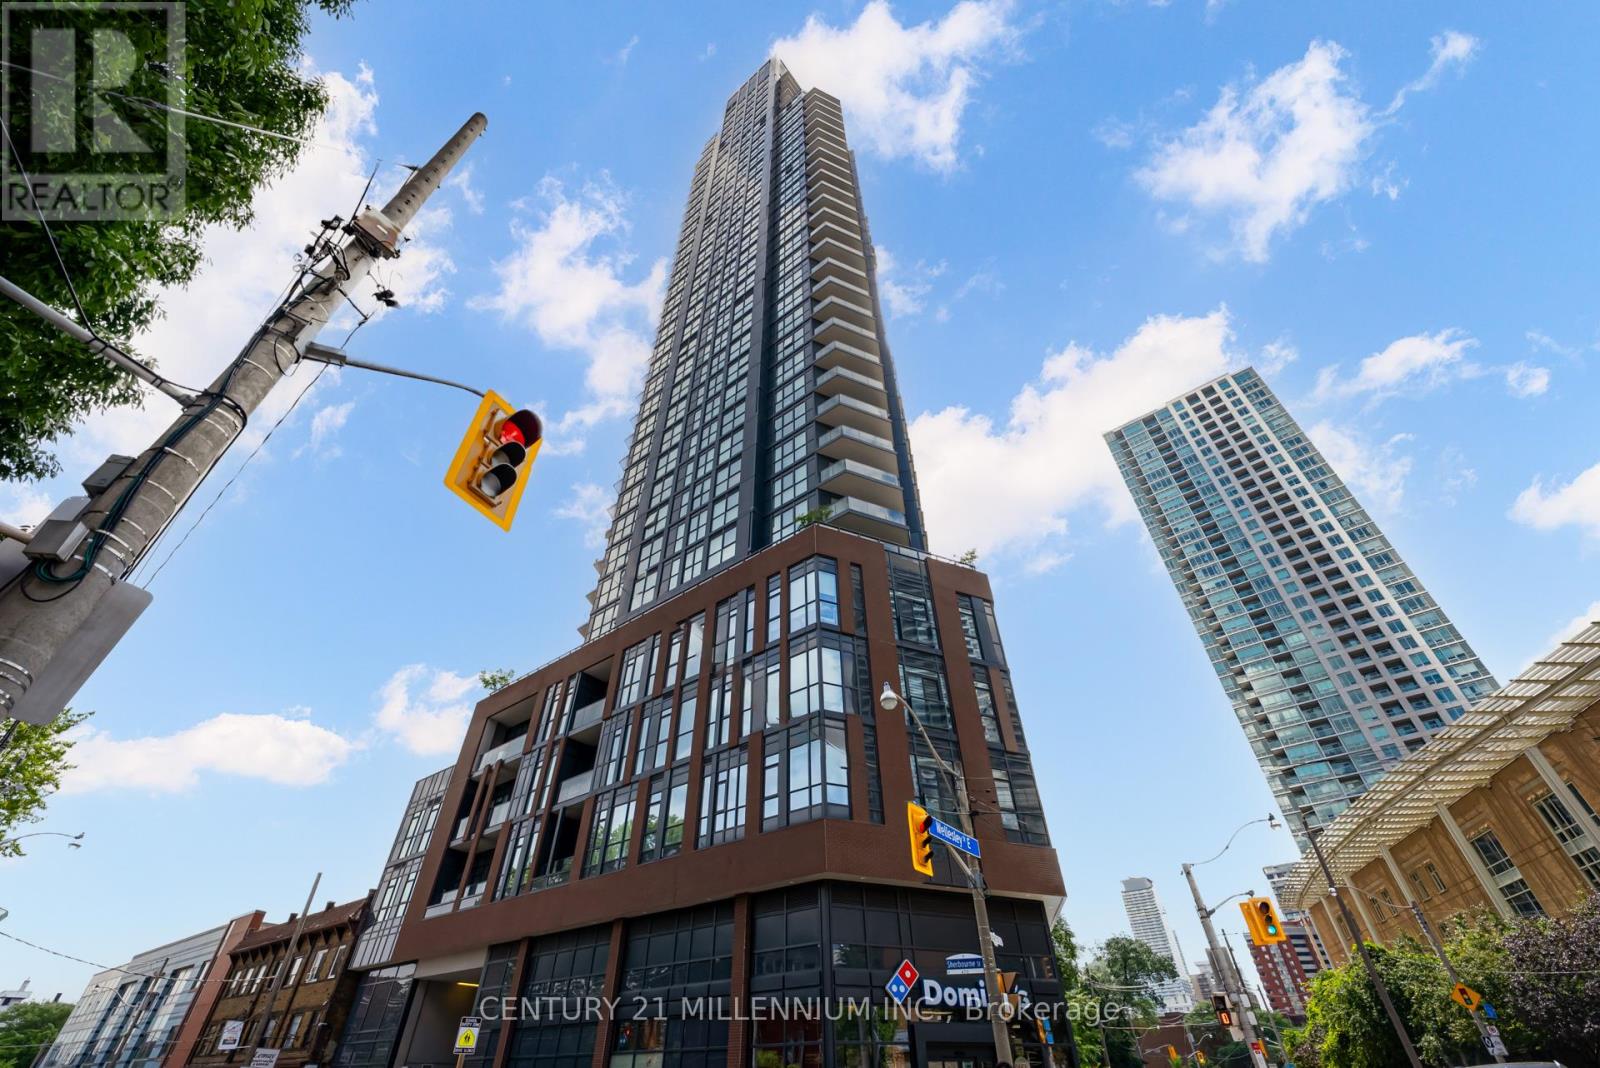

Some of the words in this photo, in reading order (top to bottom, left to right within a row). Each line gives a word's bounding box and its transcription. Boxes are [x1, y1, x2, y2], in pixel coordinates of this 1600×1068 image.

[935, 820, 963, 848] Wellesley
[966, 837, 972, 849] E
[947, 960, 975, 968] Sherbourne
[923, 979, 1032, 1014] Domi's
